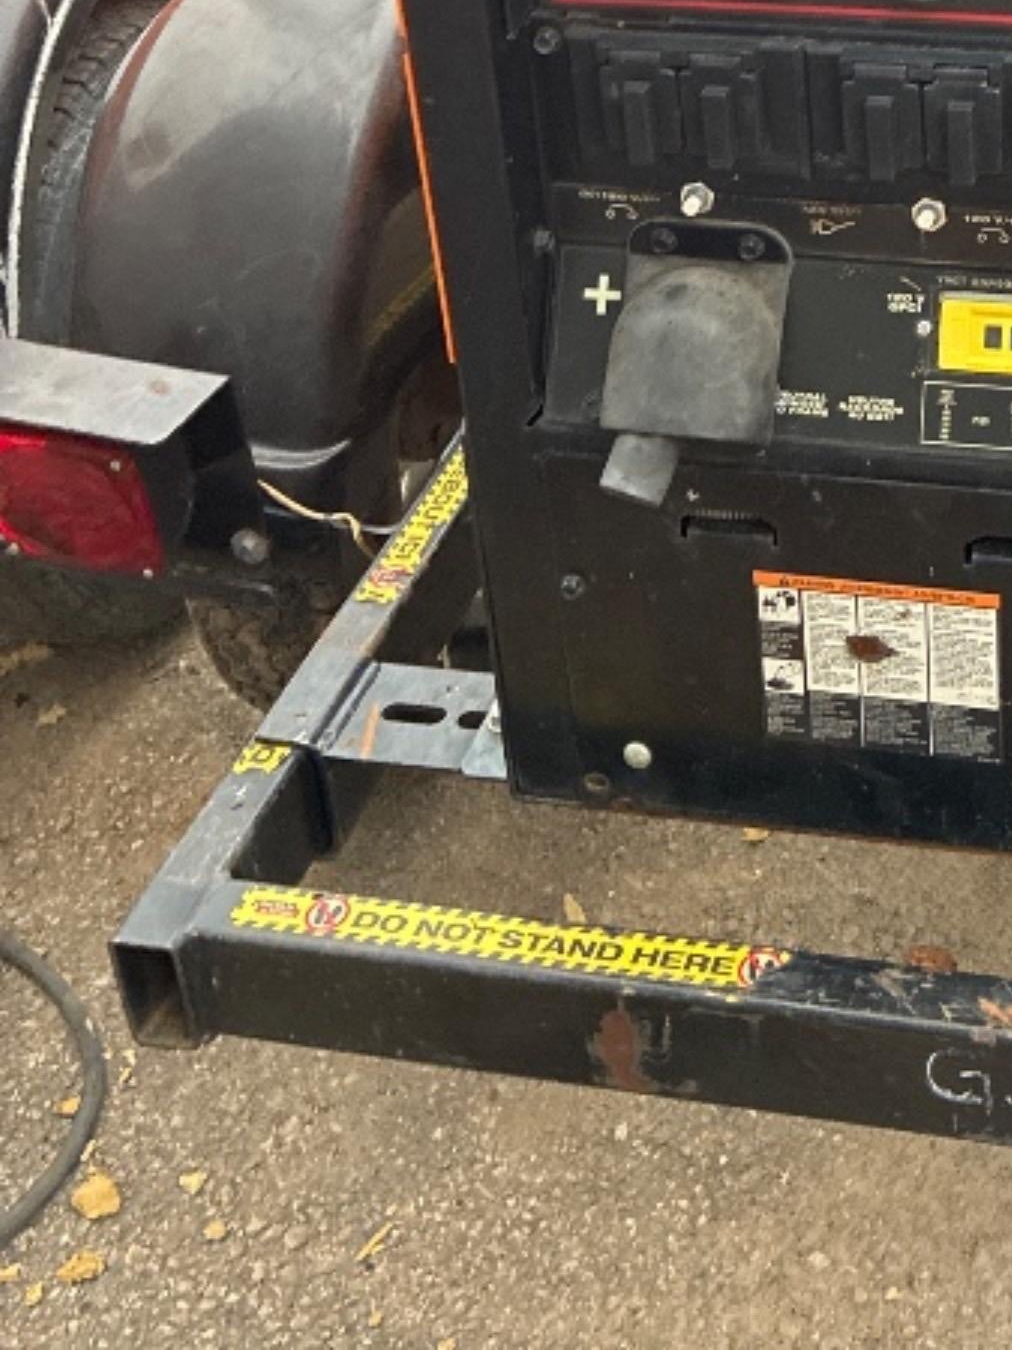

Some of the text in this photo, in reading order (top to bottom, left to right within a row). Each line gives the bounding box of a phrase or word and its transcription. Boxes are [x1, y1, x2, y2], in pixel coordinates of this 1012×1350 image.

[351, 908, 735, 978] DO NOT STAND HERE
